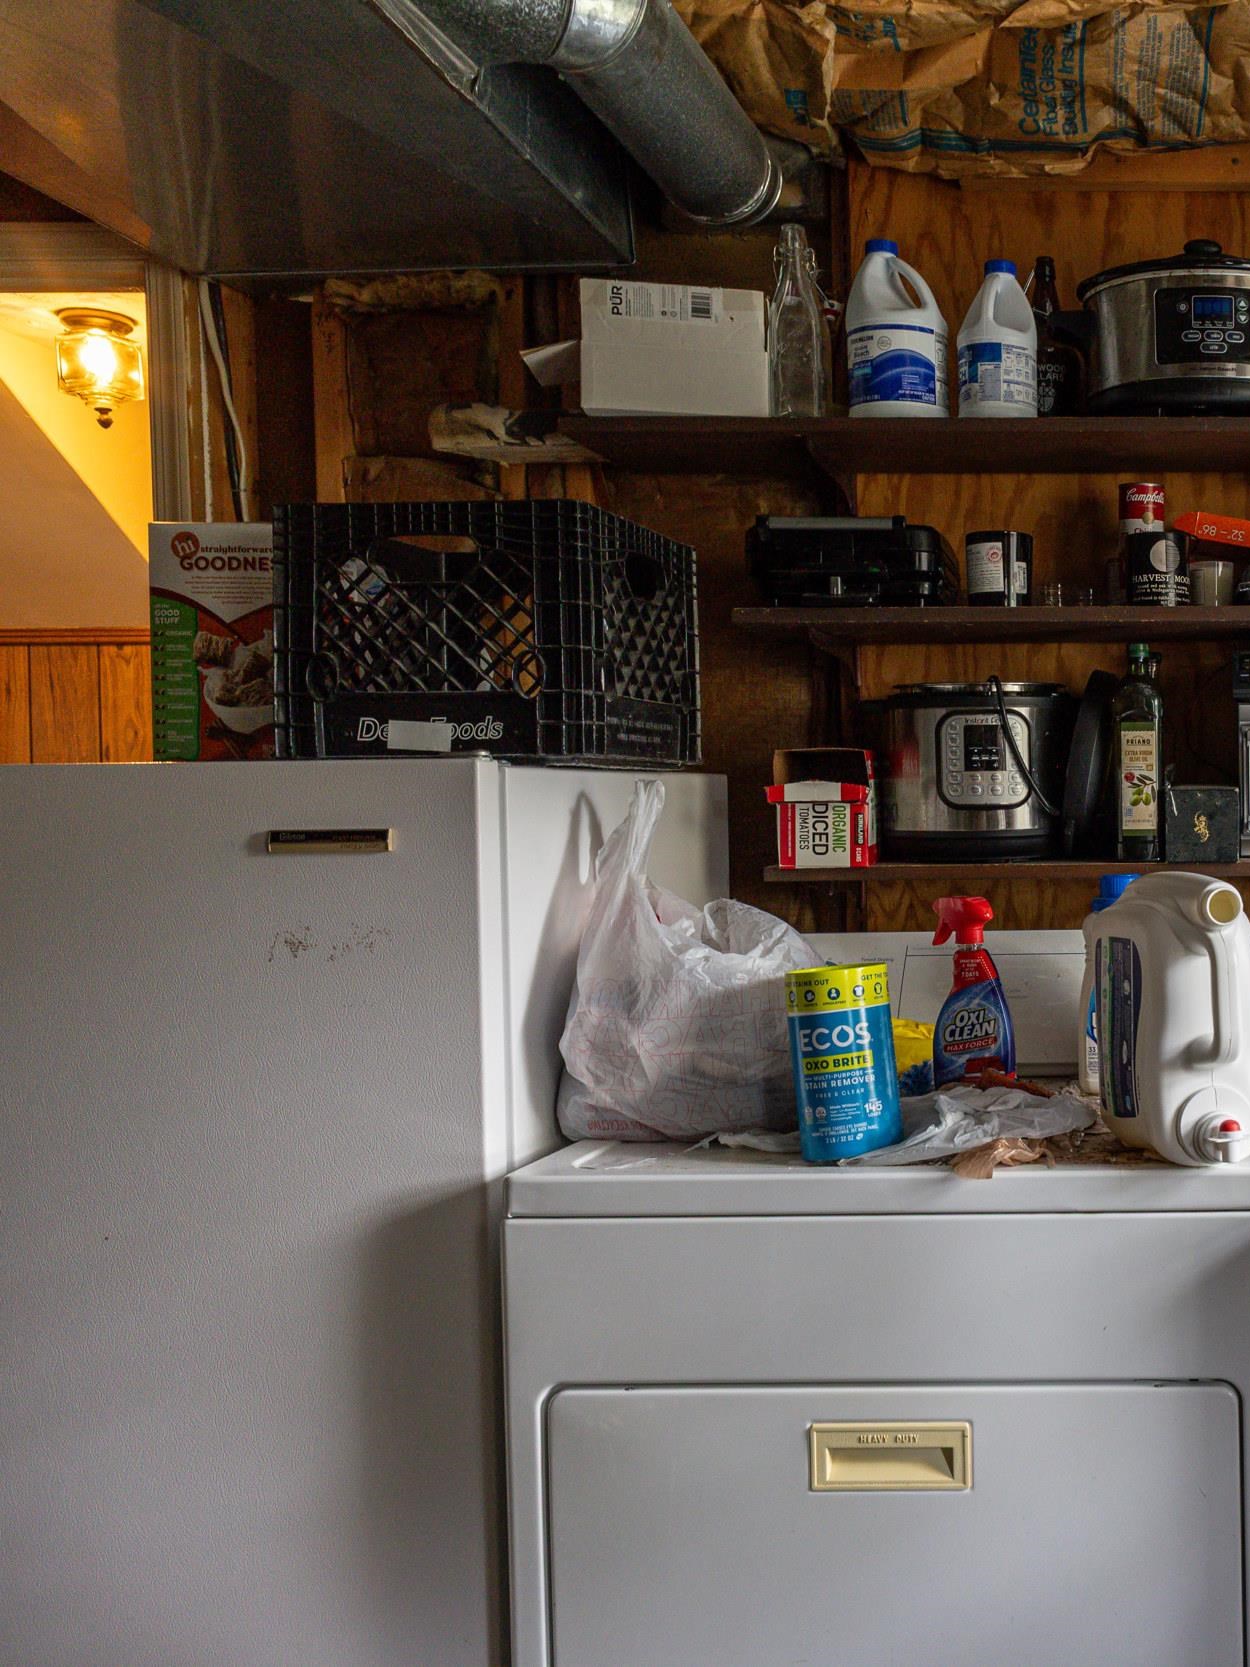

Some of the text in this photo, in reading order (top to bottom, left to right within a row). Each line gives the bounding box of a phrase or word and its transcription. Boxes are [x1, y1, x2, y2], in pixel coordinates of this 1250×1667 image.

[1039, 44, 1058, 136] Fiber Glass
[175, 537, 196, 556] hi
[180, 556, 272, 571] GOODNE
[1132, 573, 1170, 583] HARVEST
[154, 609, 180, 617] GOOD
[357, 715, 503, 741] De oods
[799, 807, 810, 850] TOMATOES
[812, 803, 829, 856] DICED
[832, 805, 847, 853] ORGANIC
[814, 979, 830, 987] OUT
[955, 1008, 985, 1027] OXI
[799, 1022, 872, 1051] ECOS
[945, 1019, 995, 1042] CLEAN
[965, 1038, 994, 1049] FORCE
[805, 1054, 870, 1072] OXO BRITE
[804, 1074, 875, 1090] STAIN REMOVER
[813, 1070, 863, 1080] MULTI-PURPOSE
[841, 1088, 865, 1096] CLEAR
[864, 1100, 883, 1113] 145
[858, 1433, 920, 1444] HEAVY DUTY
